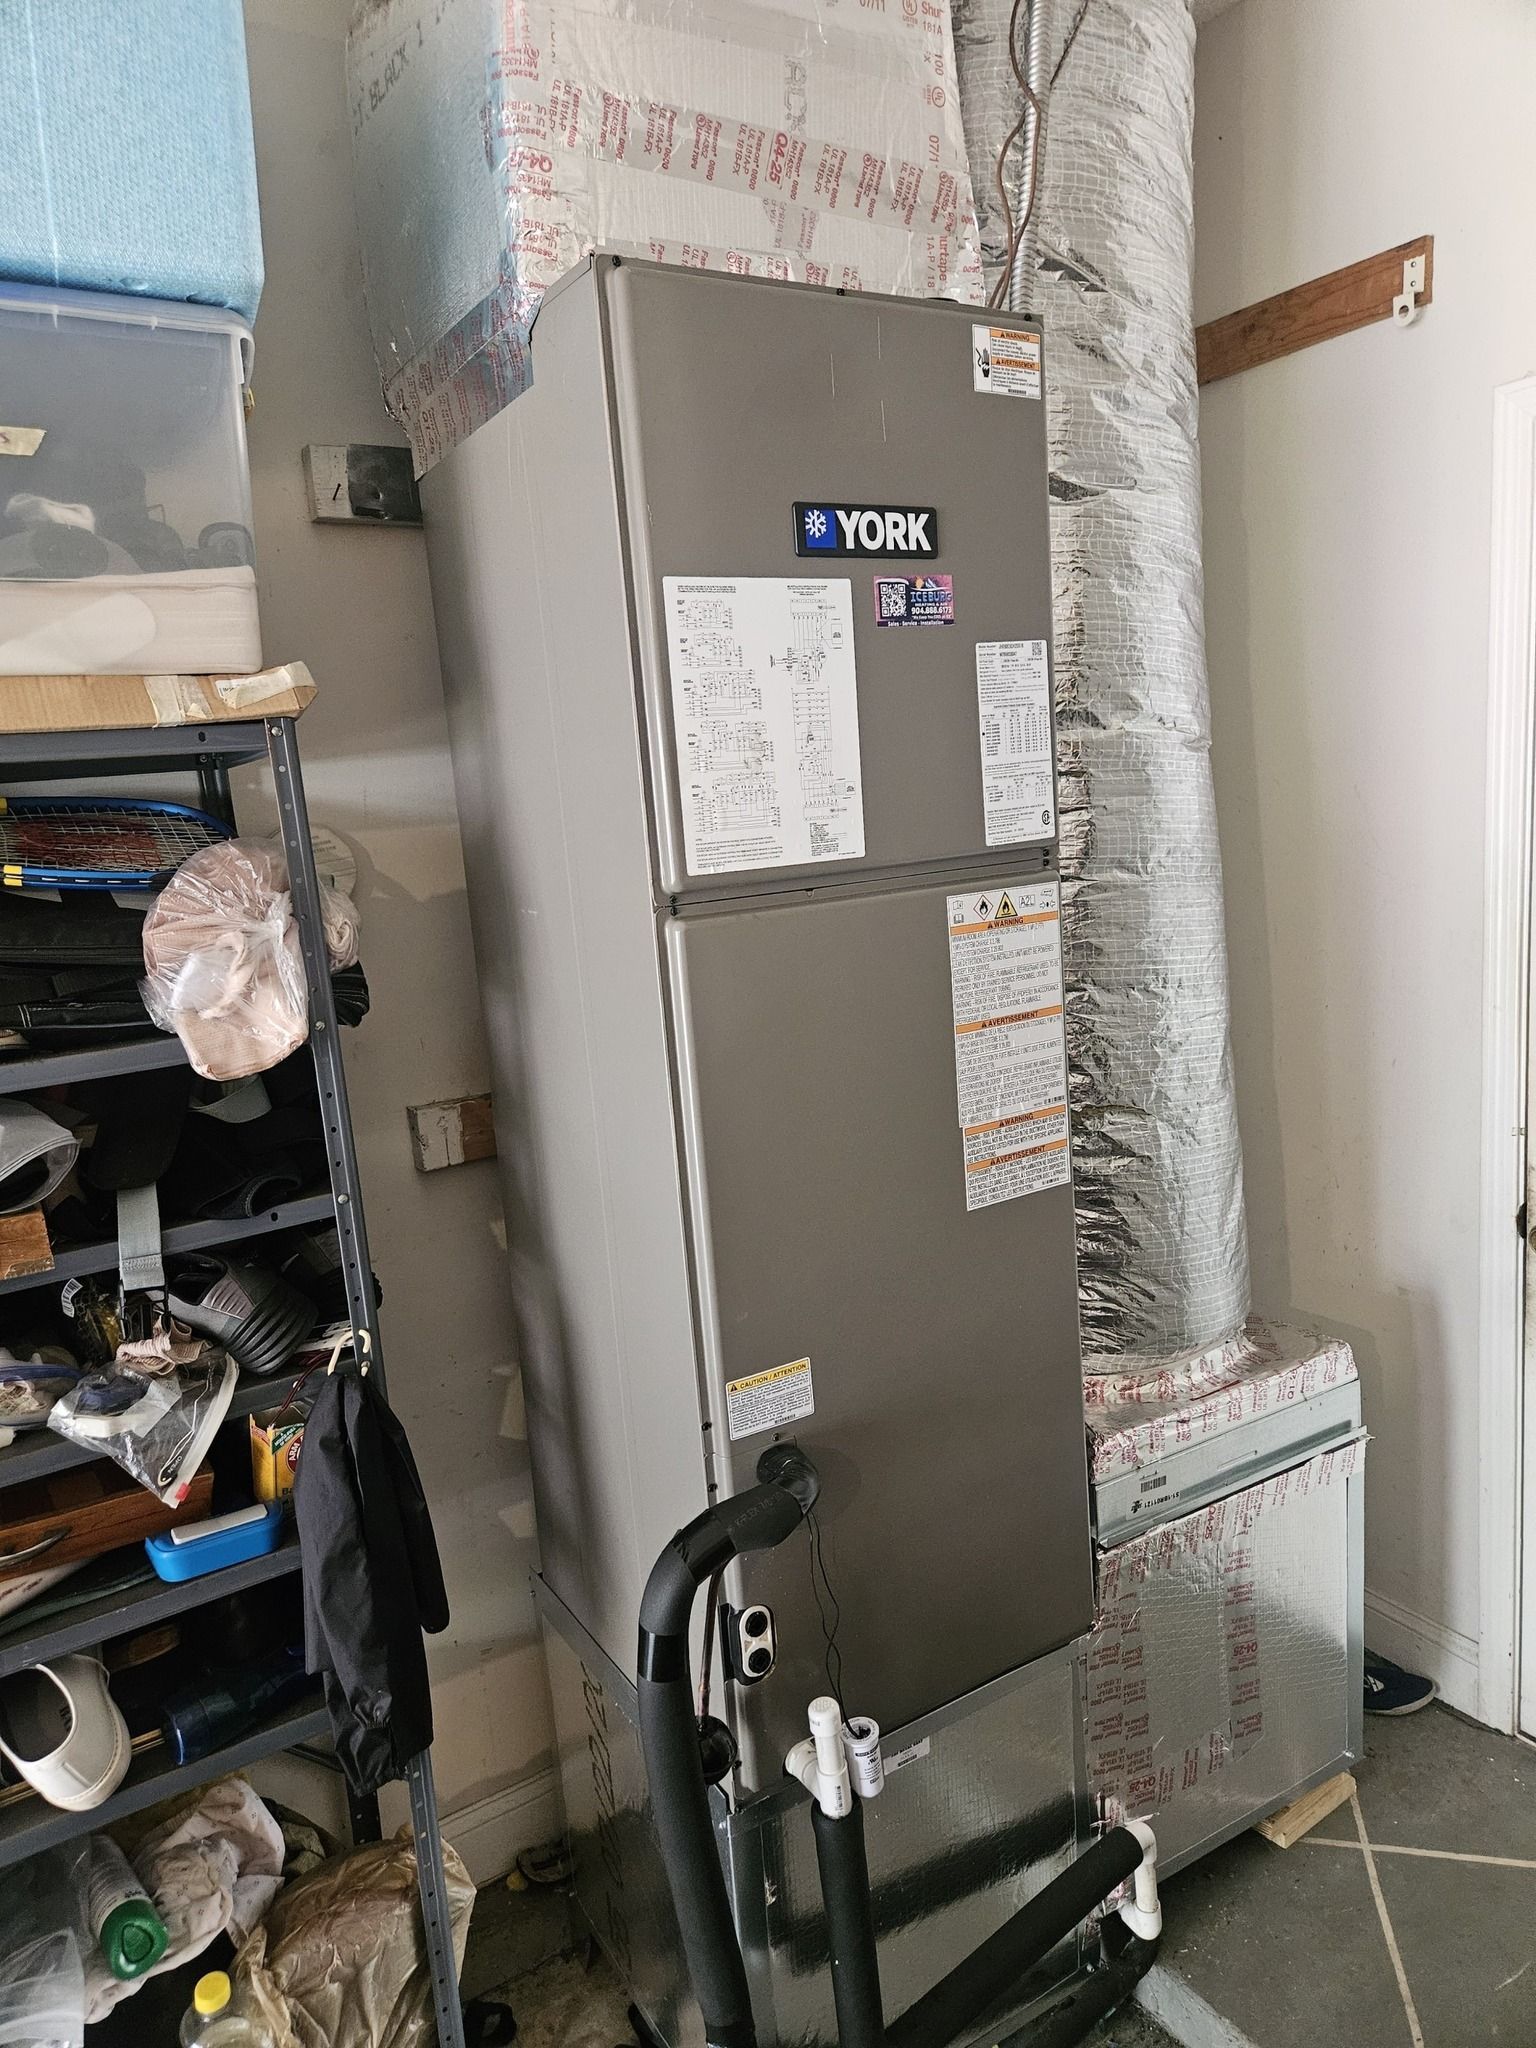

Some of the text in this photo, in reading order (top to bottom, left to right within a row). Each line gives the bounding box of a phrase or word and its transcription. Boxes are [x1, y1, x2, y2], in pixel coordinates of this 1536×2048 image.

[768, 132, 788, 185] Q4-25
[1005, 332, 1030, 342] WARNING
[835, 510, 932, 551] YORK
[910, 591, 952, 602] ICEBURG
[994, 917, 1024, 928] WARNING
[988, 1010, 1040, 1026] AVERTISSEMENT
[1004, 1113, 1034, 1126] WARNING
[996, 1146, 1046, 1164] AVERTISSEMENT
[740, 1377, 768, 1389] CAUTION
[774, 1364, 806, 1378] ATTENTION
[289, 1443, 300, 1461] ARM
